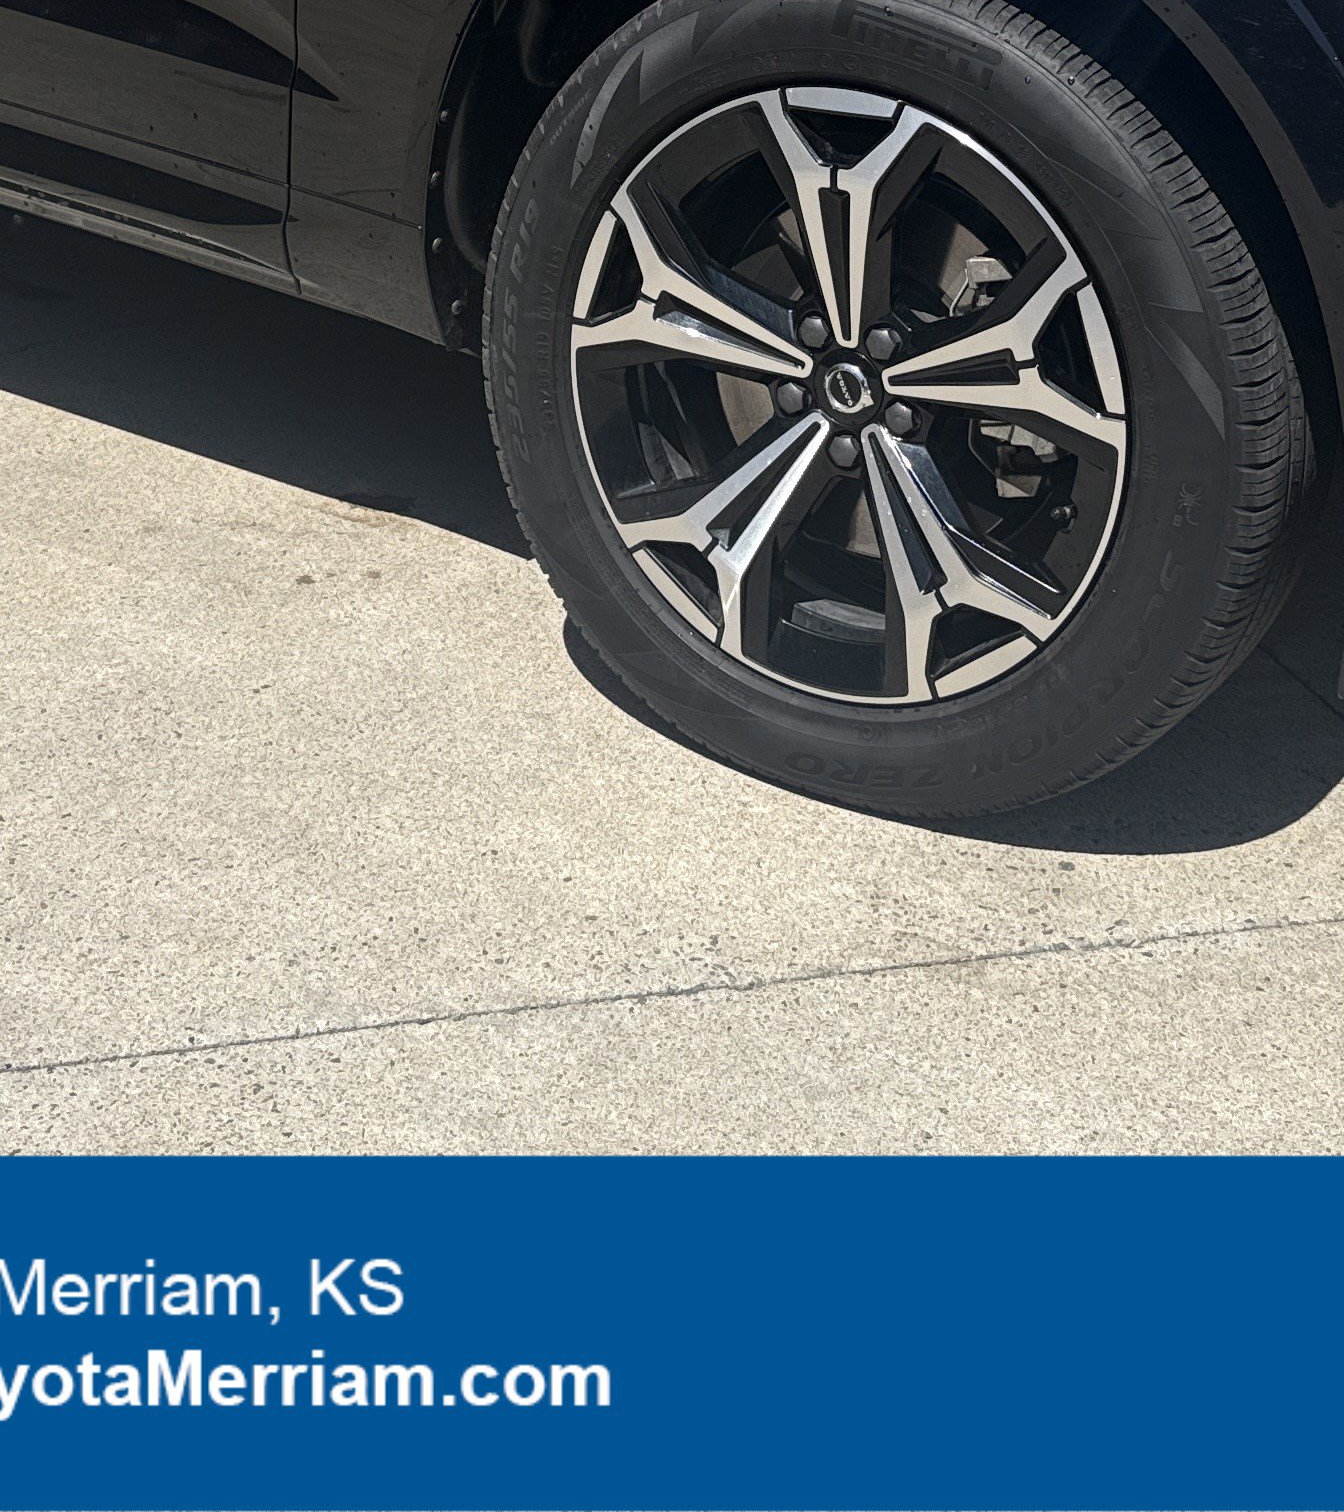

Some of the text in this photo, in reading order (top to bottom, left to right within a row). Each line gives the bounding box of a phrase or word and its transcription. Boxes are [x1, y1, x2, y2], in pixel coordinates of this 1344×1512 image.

[502, 198, 540, 464] 235/55 R19
[784, 752, 945, 788] ZERO
